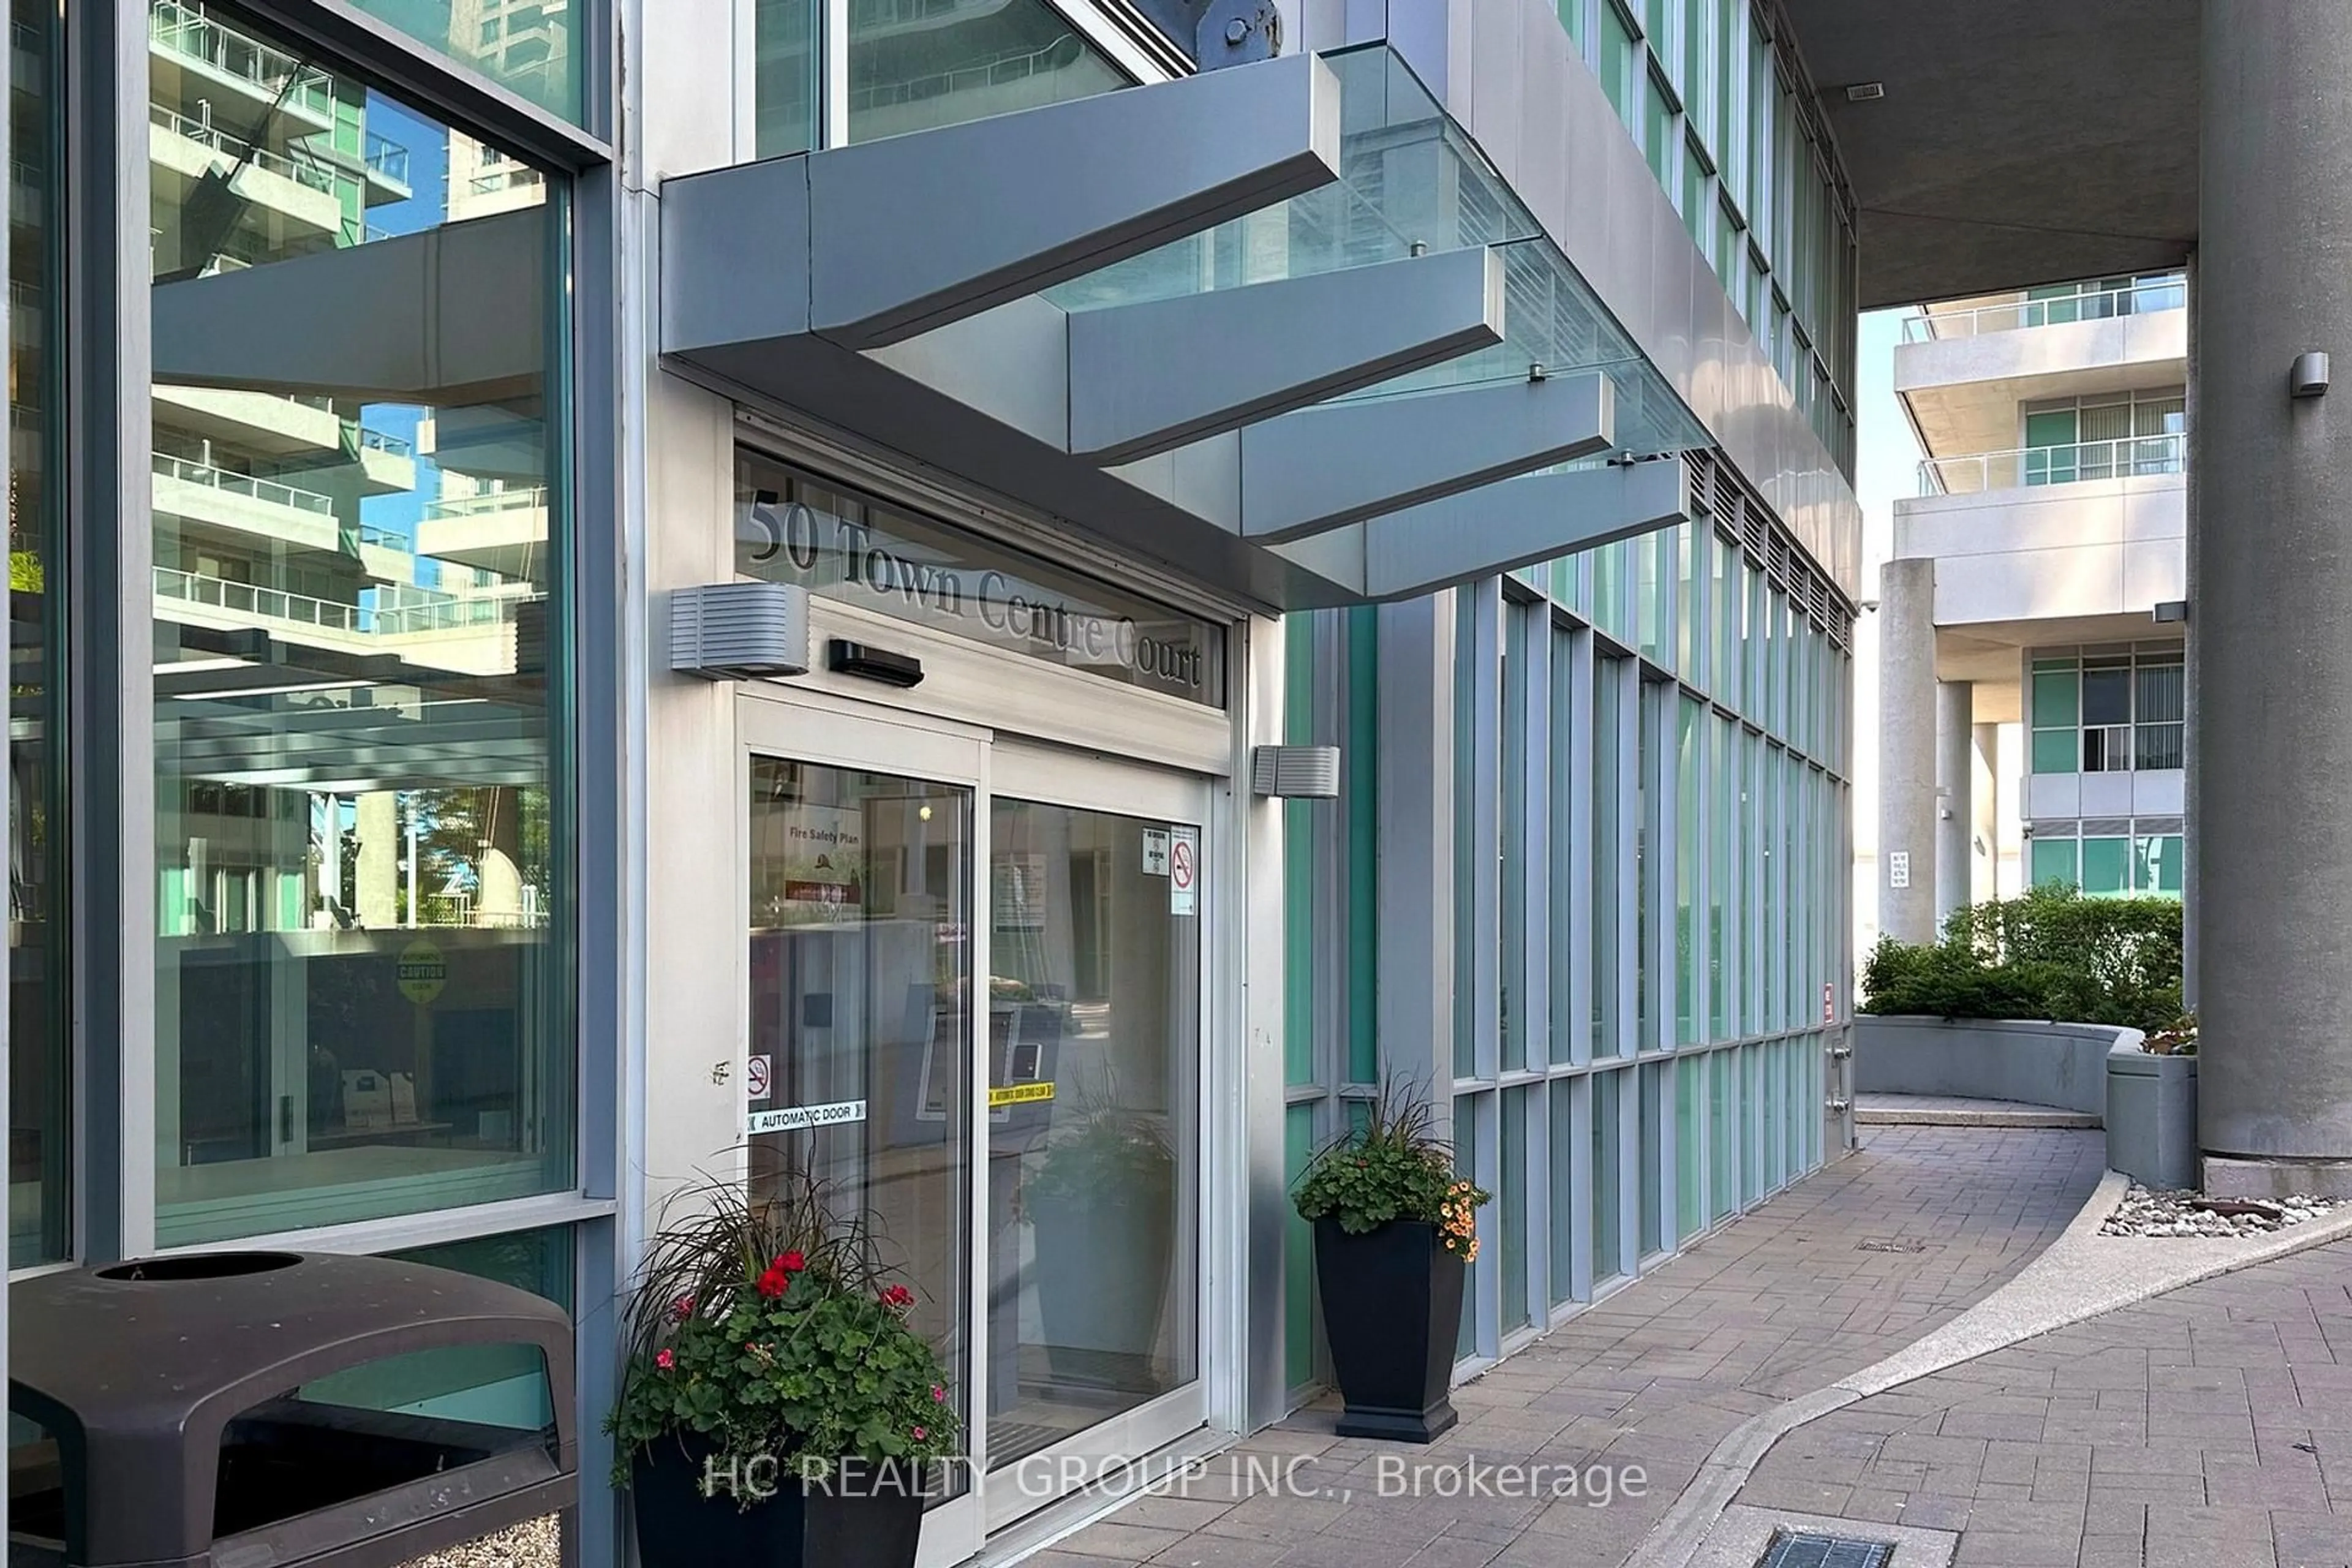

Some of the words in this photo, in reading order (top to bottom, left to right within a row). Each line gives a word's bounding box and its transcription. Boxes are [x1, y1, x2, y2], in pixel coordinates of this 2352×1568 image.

[749, 490, 818, 572] 50
[834, 514, 965, 617] Town
[977, 571, 1103, 660] Centre
[1113, 616, 1201, 688] Court
[790, 827, 807, 839] Fire
[809, 829, 837, 845] Safety
[839, 832, 859, 844] Plan
[823, 1106, 851, 1120] DOOR
